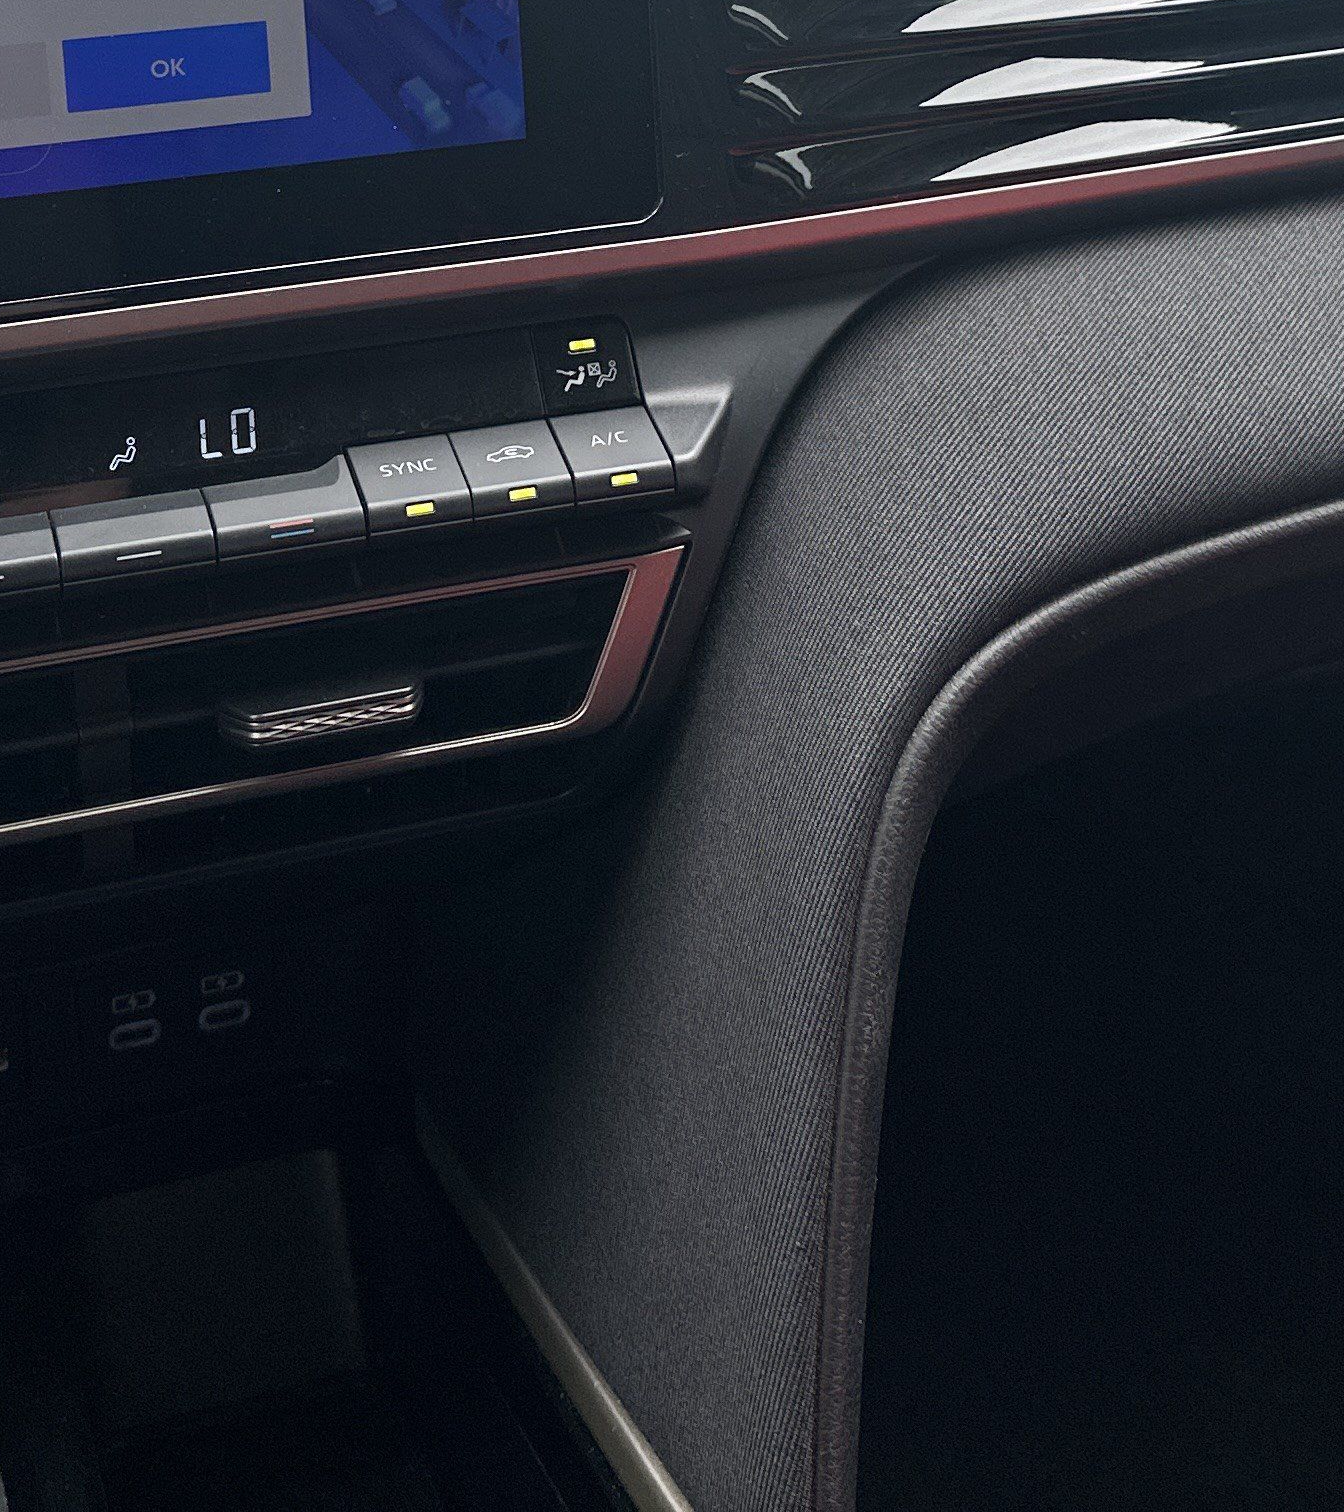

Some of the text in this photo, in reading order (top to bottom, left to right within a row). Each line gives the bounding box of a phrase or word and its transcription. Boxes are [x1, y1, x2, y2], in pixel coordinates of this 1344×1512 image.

[150, 57, 186, 79] OK
[591, 430, 629, 448] A/C
[379, 458, 438, 479] SYNC
